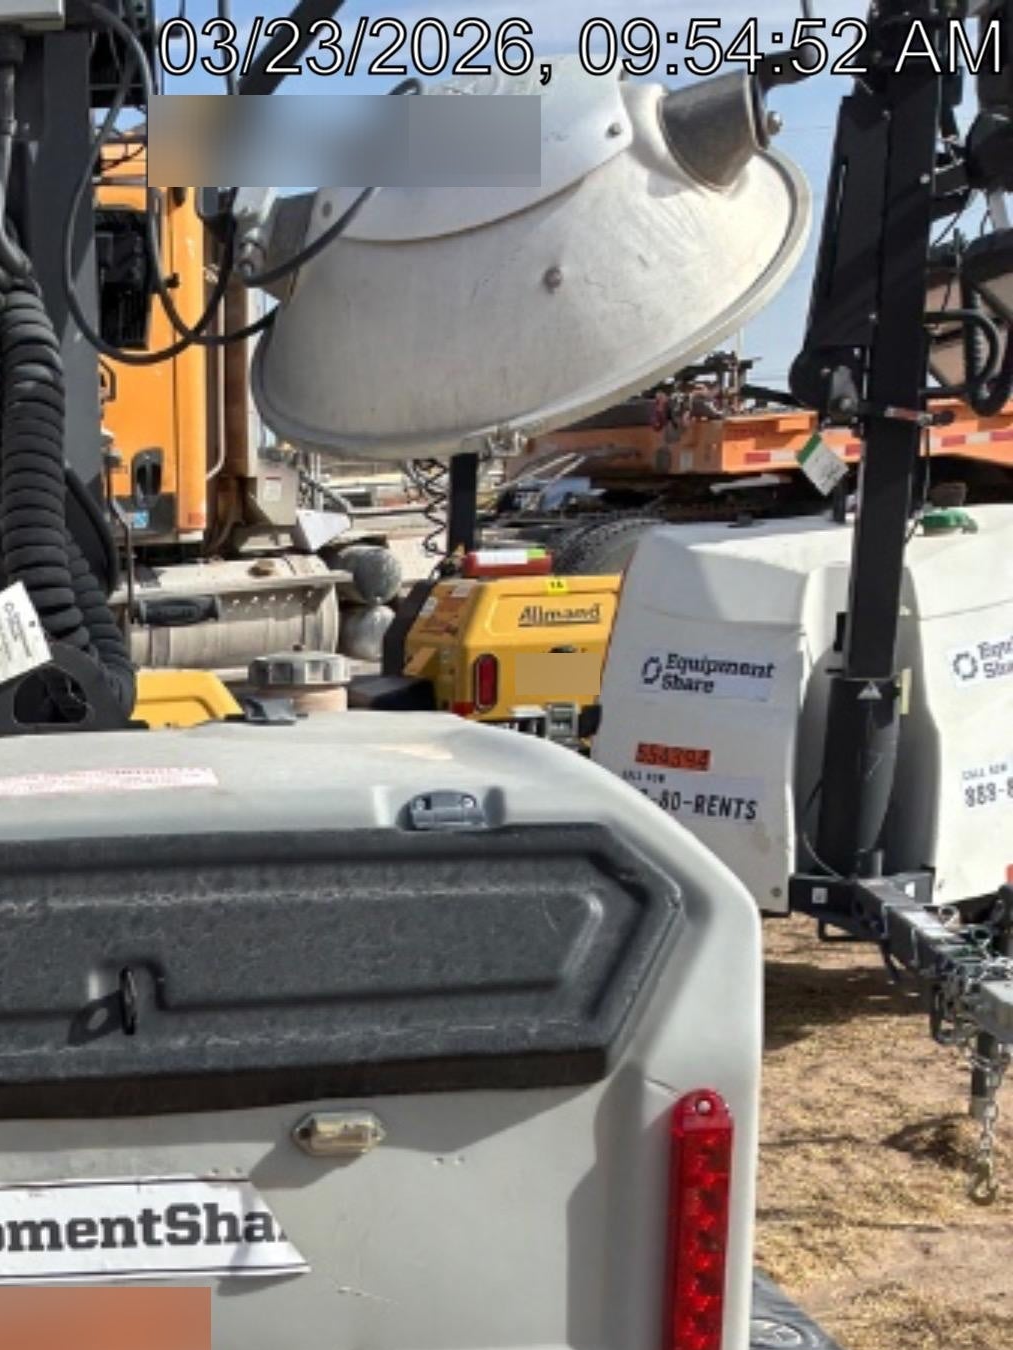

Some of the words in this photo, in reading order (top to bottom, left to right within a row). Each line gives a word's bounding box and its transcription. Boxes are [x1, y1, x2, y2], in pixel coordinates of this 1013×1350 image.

[517, 604, 601, 626] Allmand
[665, 653, 775, 678] Equipment
[661, 673, 715, 693] Share
